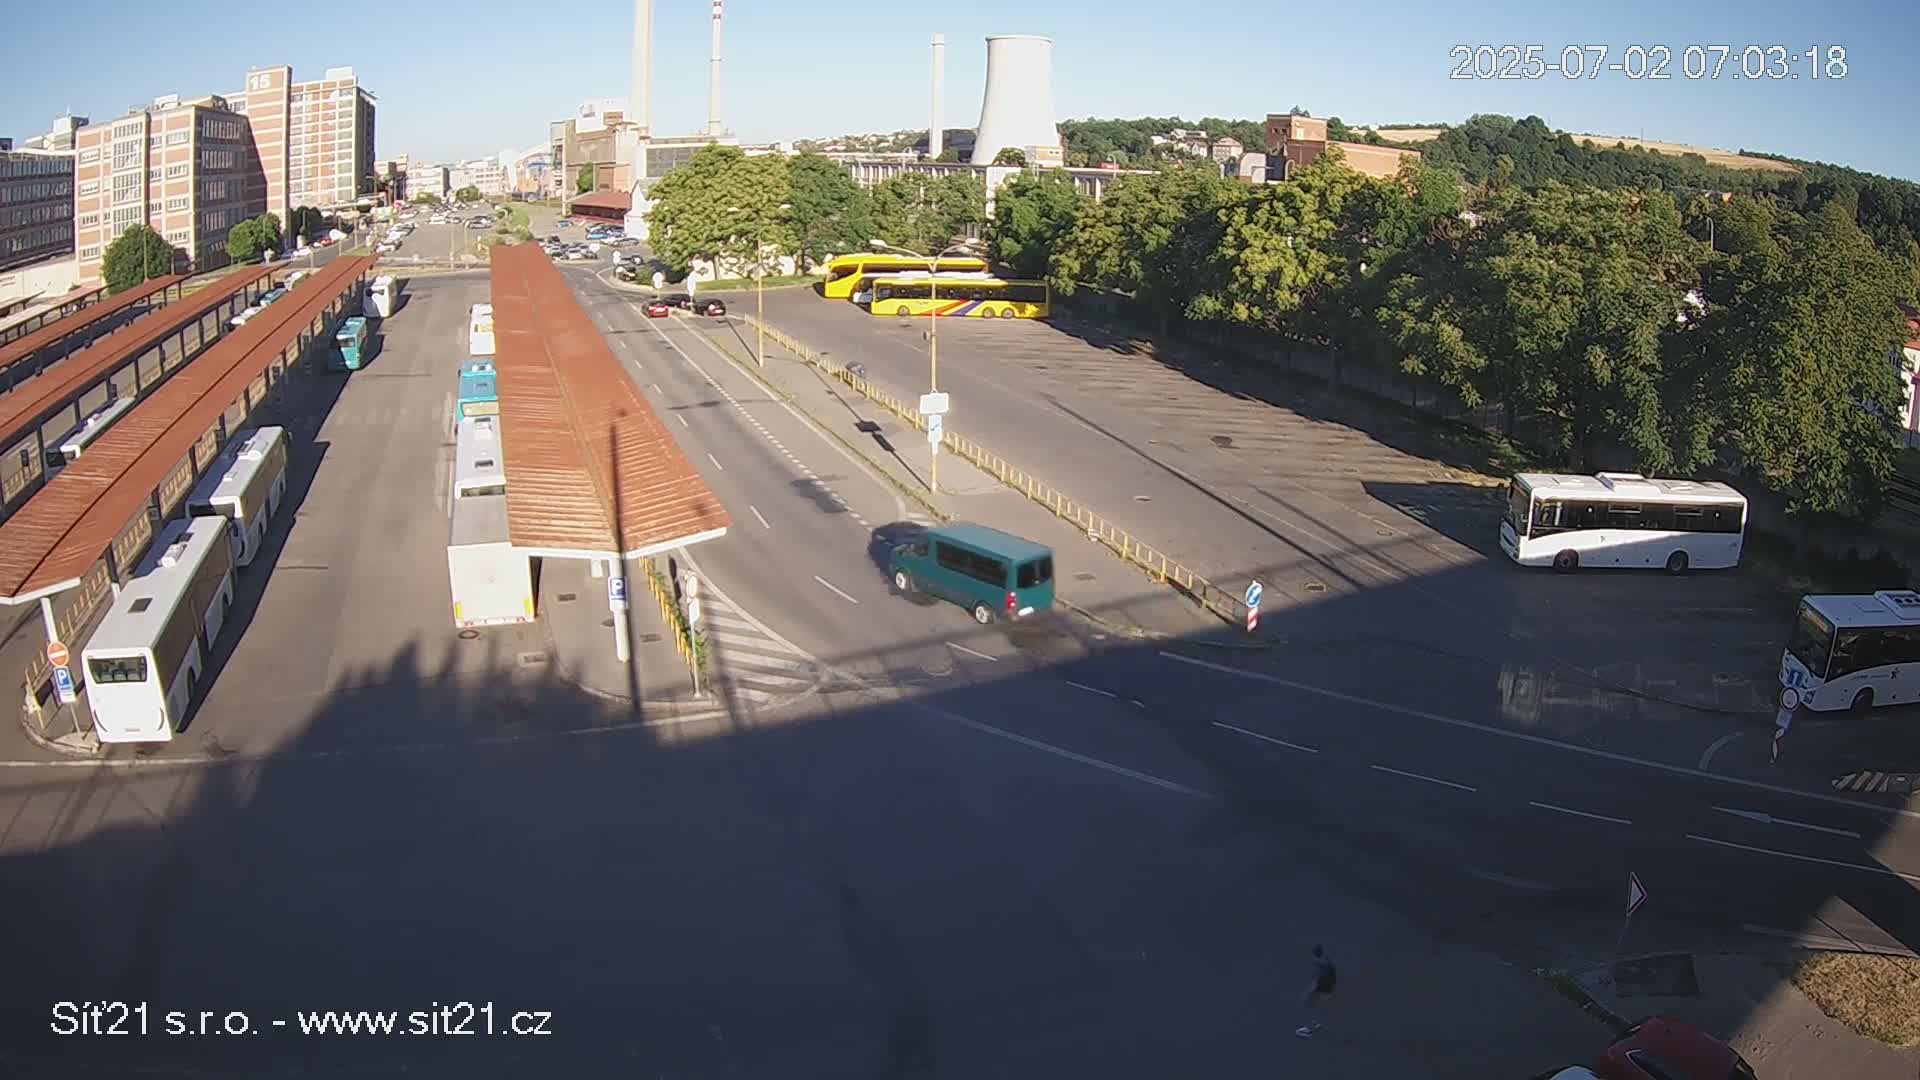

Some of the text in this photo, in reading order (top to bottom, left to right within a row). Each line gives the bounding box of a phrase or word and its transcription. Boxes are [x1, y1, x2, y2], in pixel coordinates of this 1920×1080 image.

[249, 74, 271, 90] 15
[612, 580, 623, 595] P
[57, 669, 68, 685] P
